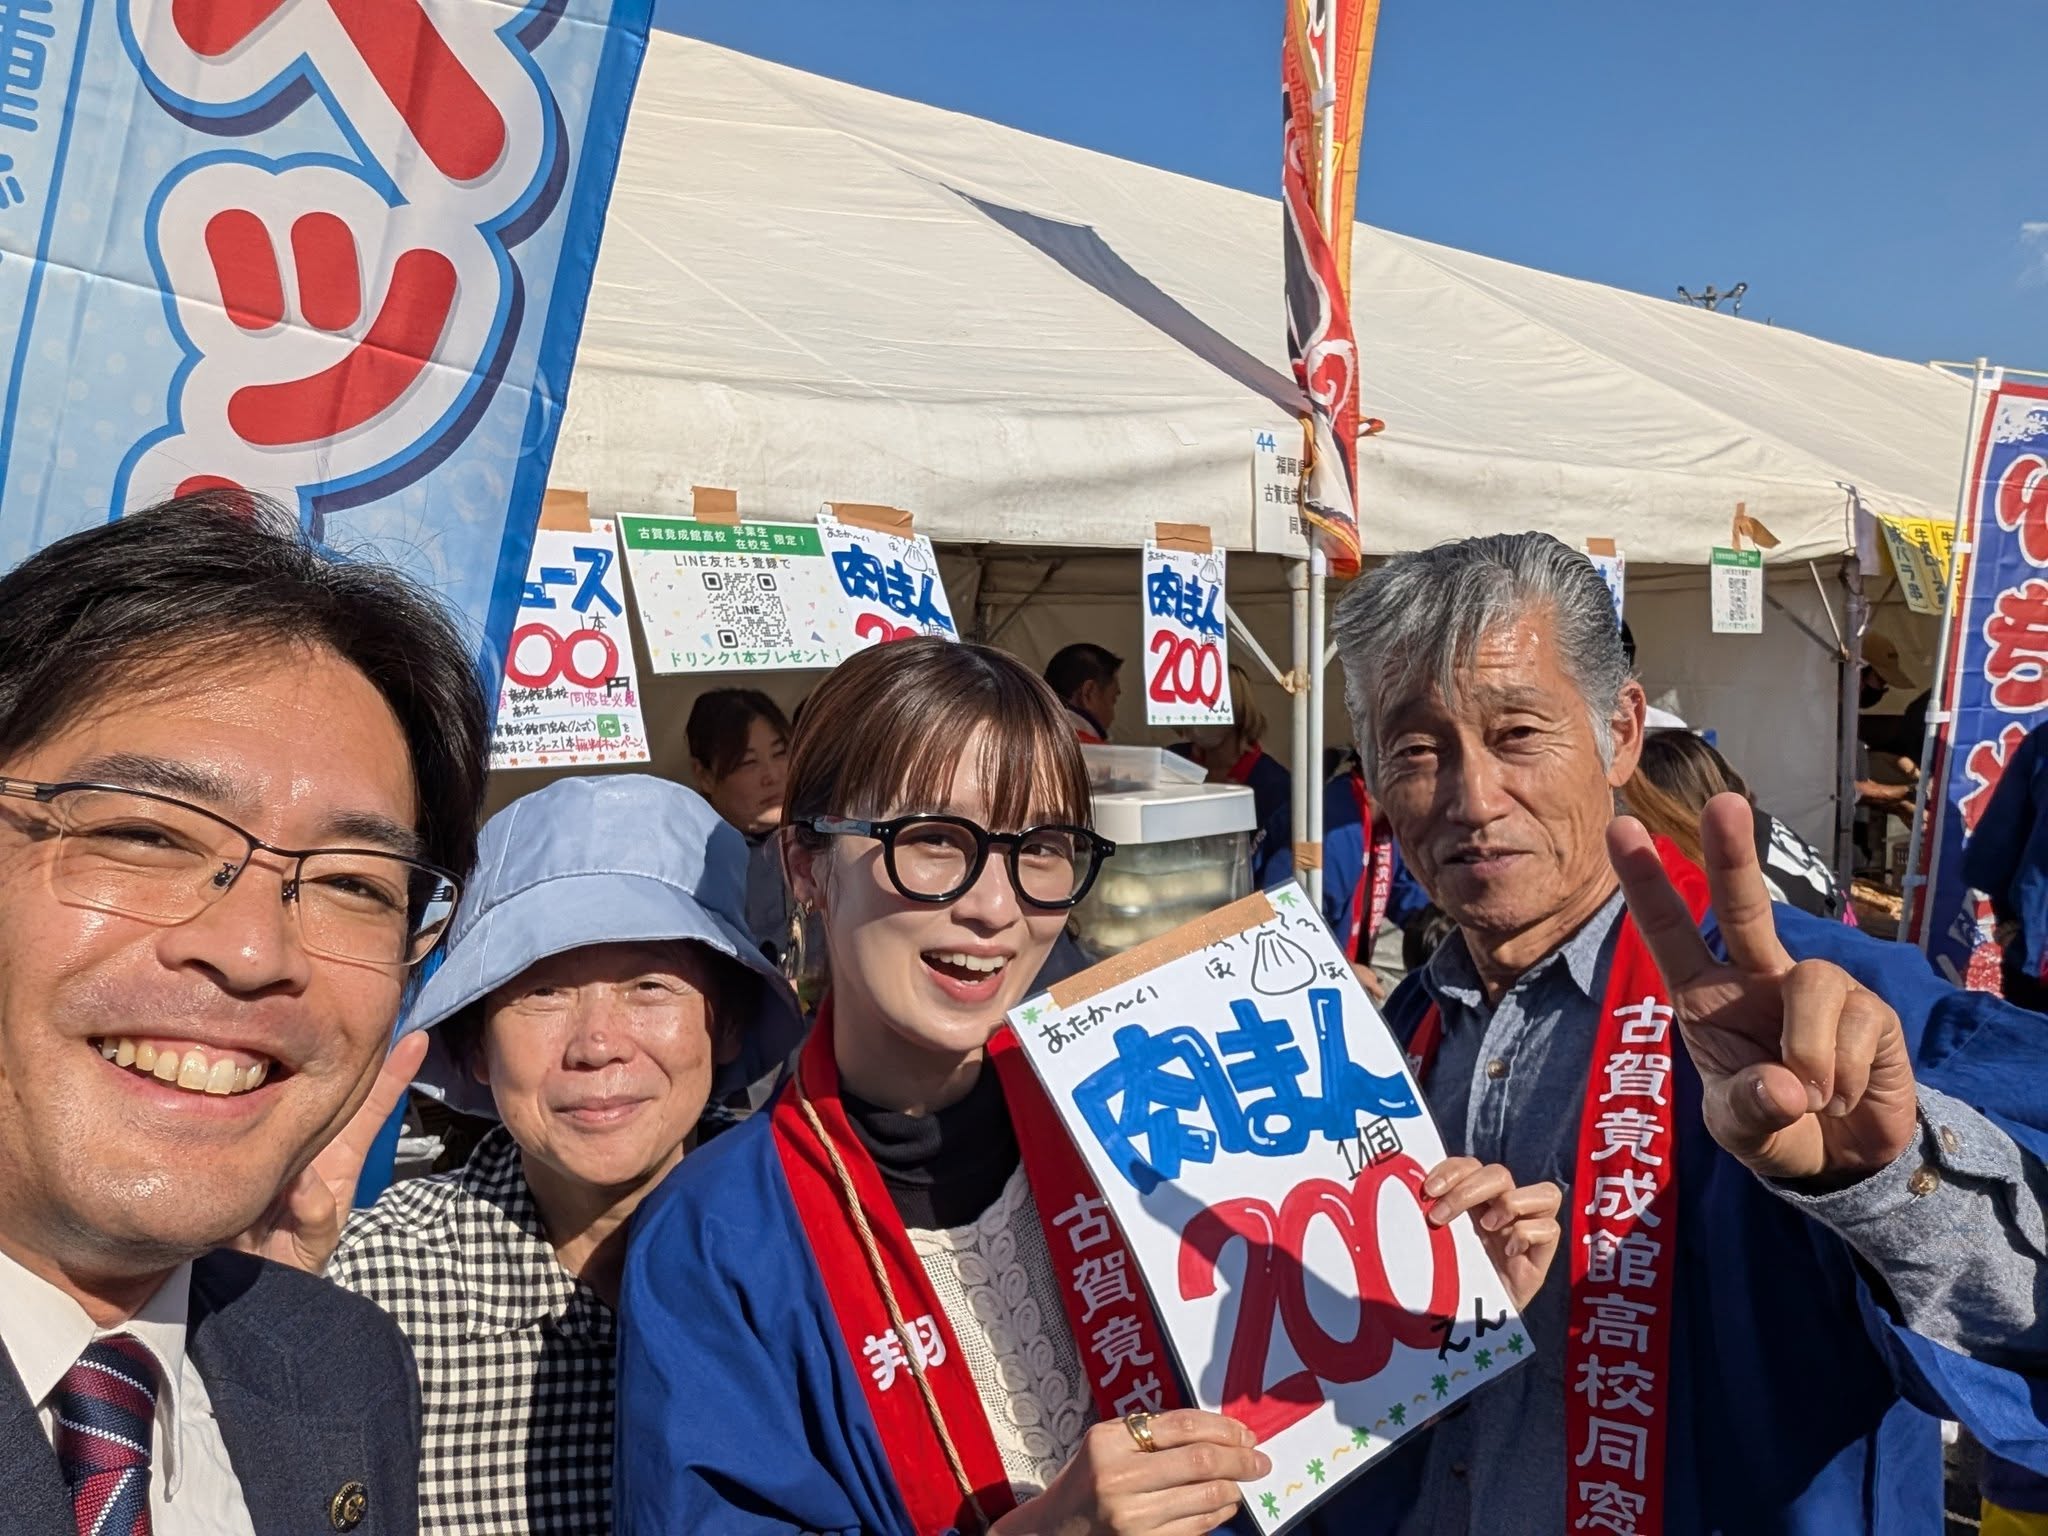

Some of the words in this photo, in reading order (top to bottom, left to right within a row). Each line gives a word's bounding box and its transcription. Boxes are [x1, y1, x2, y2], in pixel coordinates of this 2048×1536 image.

[1256, 432, 1277, 453] 44
[733, 526, 769, 538] 卒業生
[736, 539, 773, 551] 在校生
[674, 555, 792, 570] LINE友だち登録で
[735, 605, 762, 616] LINE
[831, 543, 955, 634] 肉まん
[1147, 564, 1225, 639] 肉まん
[605, 676, 630, 698] 円
[1149, 629, 1223, 709] 200
[1072, 987, 1423, 1196] 肉まん
[1336, 1114, 1404, 1182] 1個
[1178, 1152, 1460, 1446] 200
[1430, 1296, 1507, 1362] えん
